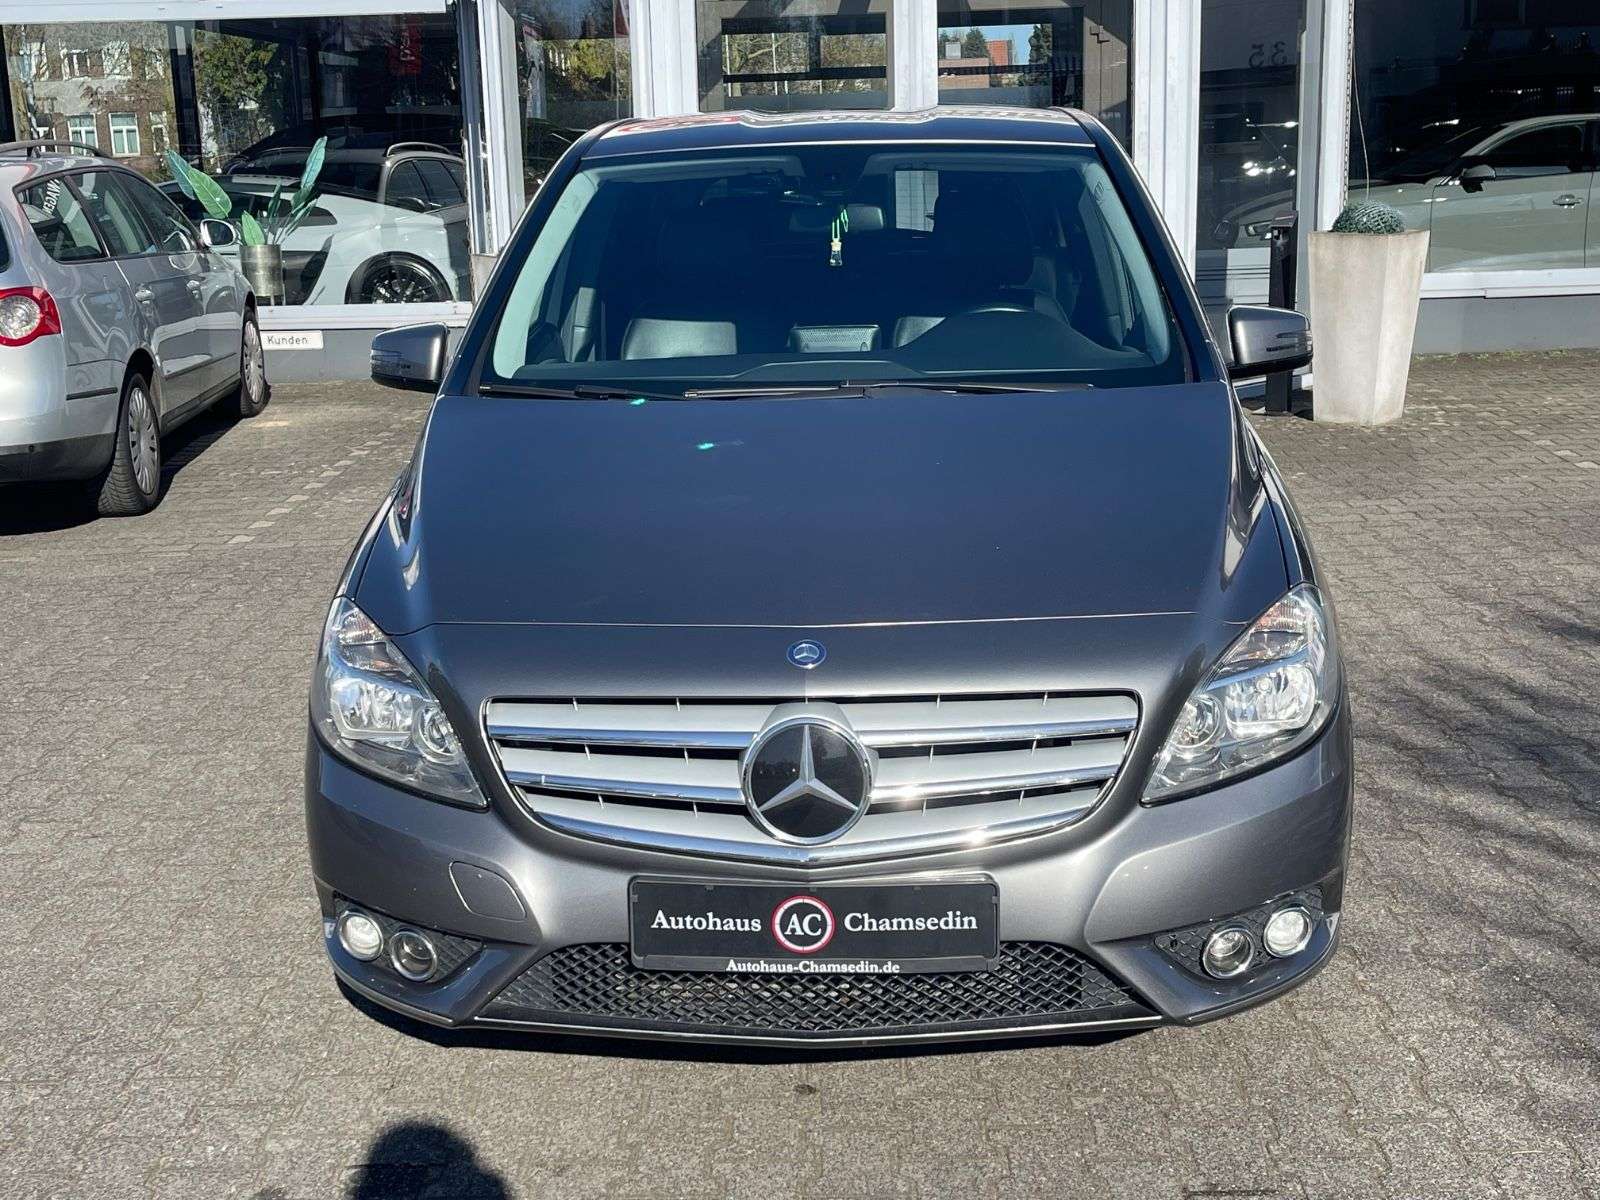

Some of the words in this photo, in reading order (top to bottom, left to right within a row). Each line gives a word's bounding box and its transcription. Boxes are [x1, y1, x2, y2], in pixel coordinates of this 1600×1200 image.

[266, 335, 309, 345] Kunden
[650, 910, 762, 932] Autohaus
[784, 913, 822, 937] AC
[843, 912, 978, 932] Chamsedin
[725, 958, 900, 974] Autohaus-Chamsedin.de
